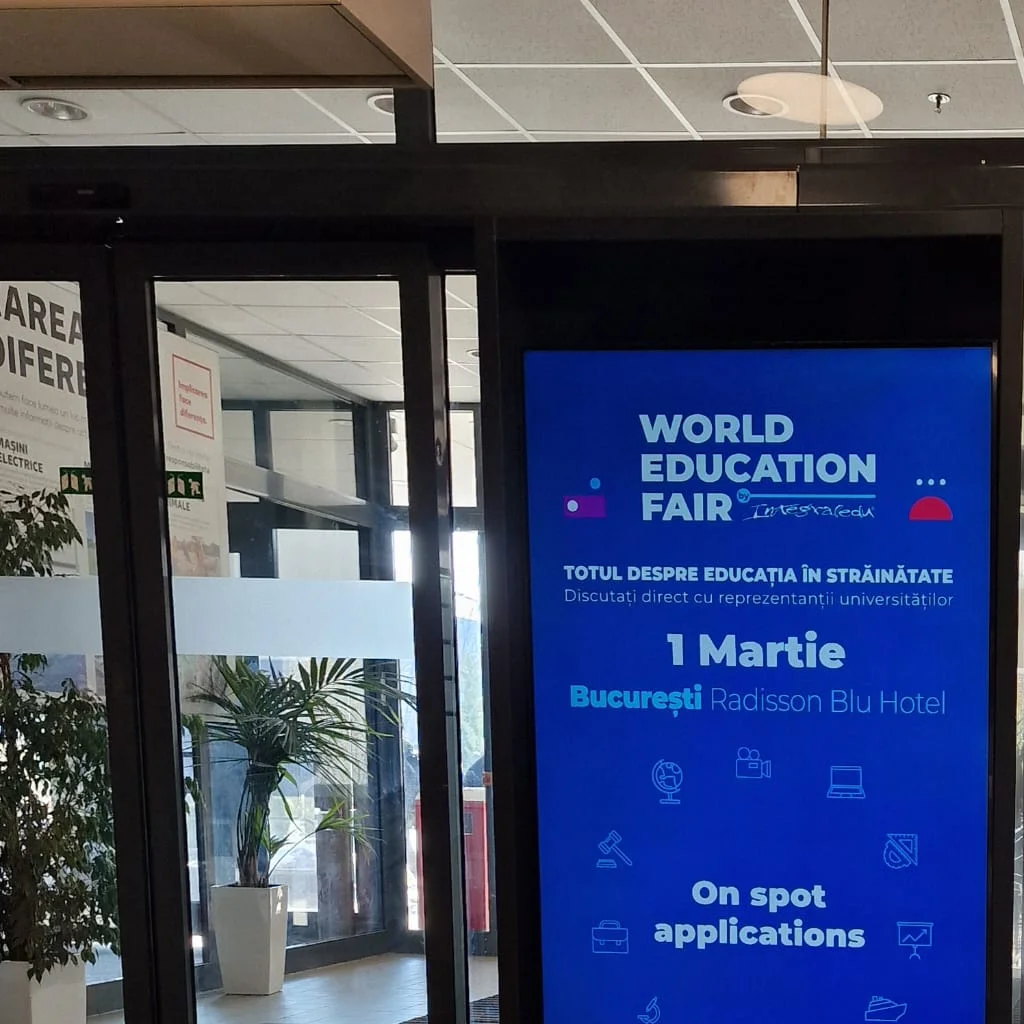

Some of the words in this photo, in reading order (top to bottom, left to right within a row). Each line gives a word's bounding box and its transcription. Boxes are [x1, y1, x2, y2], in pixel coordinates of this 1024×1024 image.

[638, 413, 795, 444] WORLD
[640, 452, 877, 484] EDUCATION
[641, 492, 734, 522] FAIR
[563, 565, 624, 581] TOTUL
[627, 565, 700, 583] DESPRE
[703, 566, 799, 588] EDUCAȚIA
[801, 563, 822, 584] ÎN
[825, 563, 955, 585] STRĂINĂTATE
[564, 588, 637, 607] Discutați
[641, 588, 689, 604] direct
[695, 593, 713, 604] cu
[718, 591, 835, 610] reprezentanții
[839, 591, 954, 611] universităților
[666, 633, 685, 666] 1
[698, 630, 847, 669] Martie
[570, 683, 703, 718] București
[711, 687, 822, 713] Radisson
[831, 688, 871, 714] Blu
[880, 690, 946, 715] Hotel
[691, 879, 740, 906] On
[749, 884, 828, 913] spot
[653, 916, 867, 950] applications
